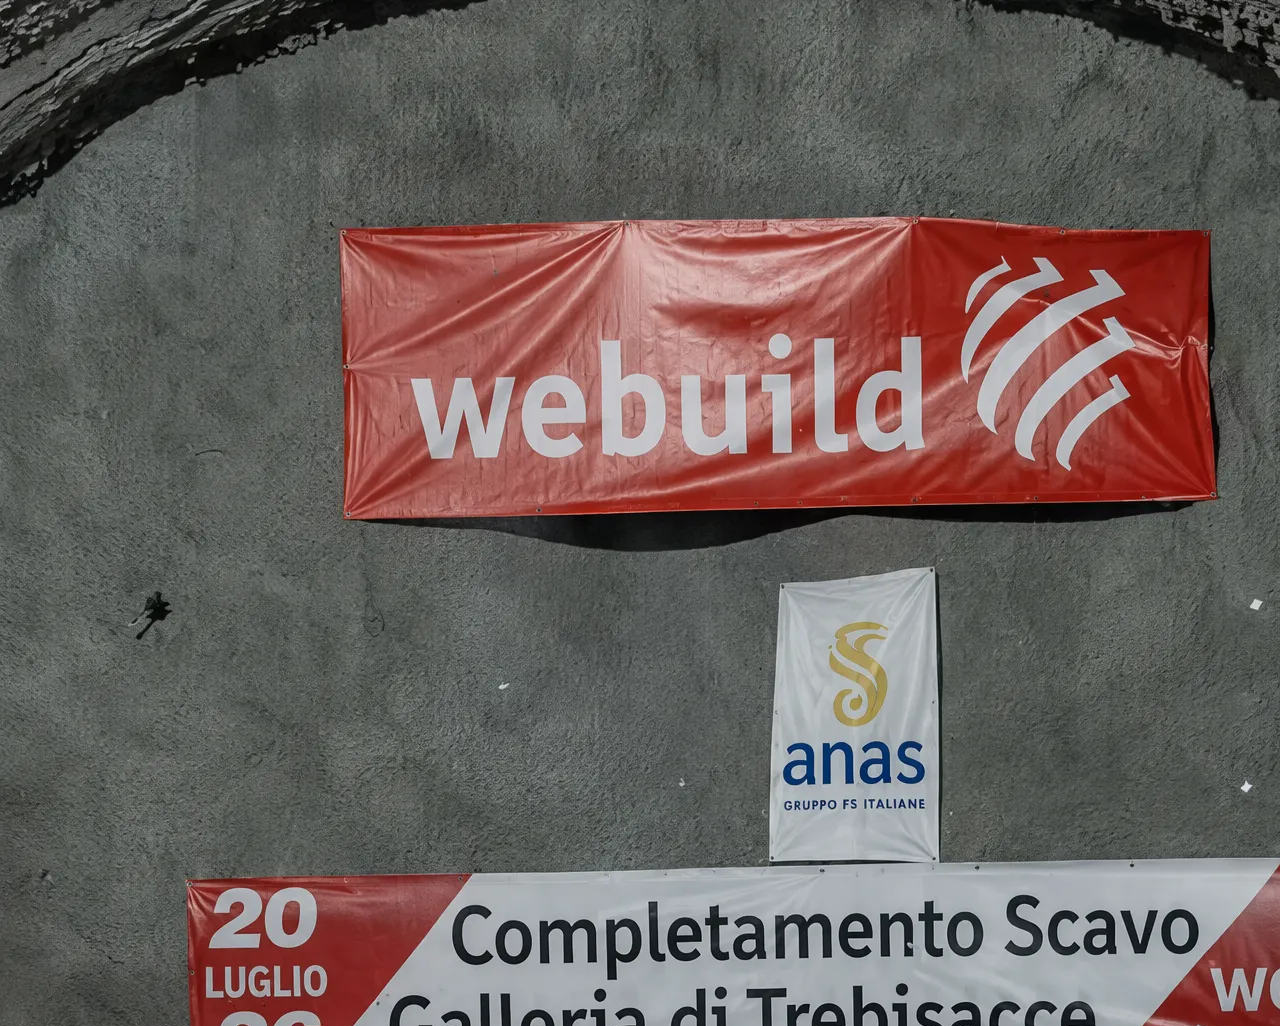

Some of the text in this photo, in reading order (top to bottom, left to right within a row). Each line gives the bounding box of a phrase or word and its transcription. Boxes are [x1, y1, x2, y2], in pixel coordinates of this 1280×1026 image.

[410, 333, 926, 460] webuild
[782, 740, 926, 786] anas
[783, 798, 926, 811] GRUPPO FS ITALIANE
[208, 886, 318, 949] 20
[451, 894, 1200, 981] Completamento Scavo
[205, 964, 328, 999] LUGLIO
